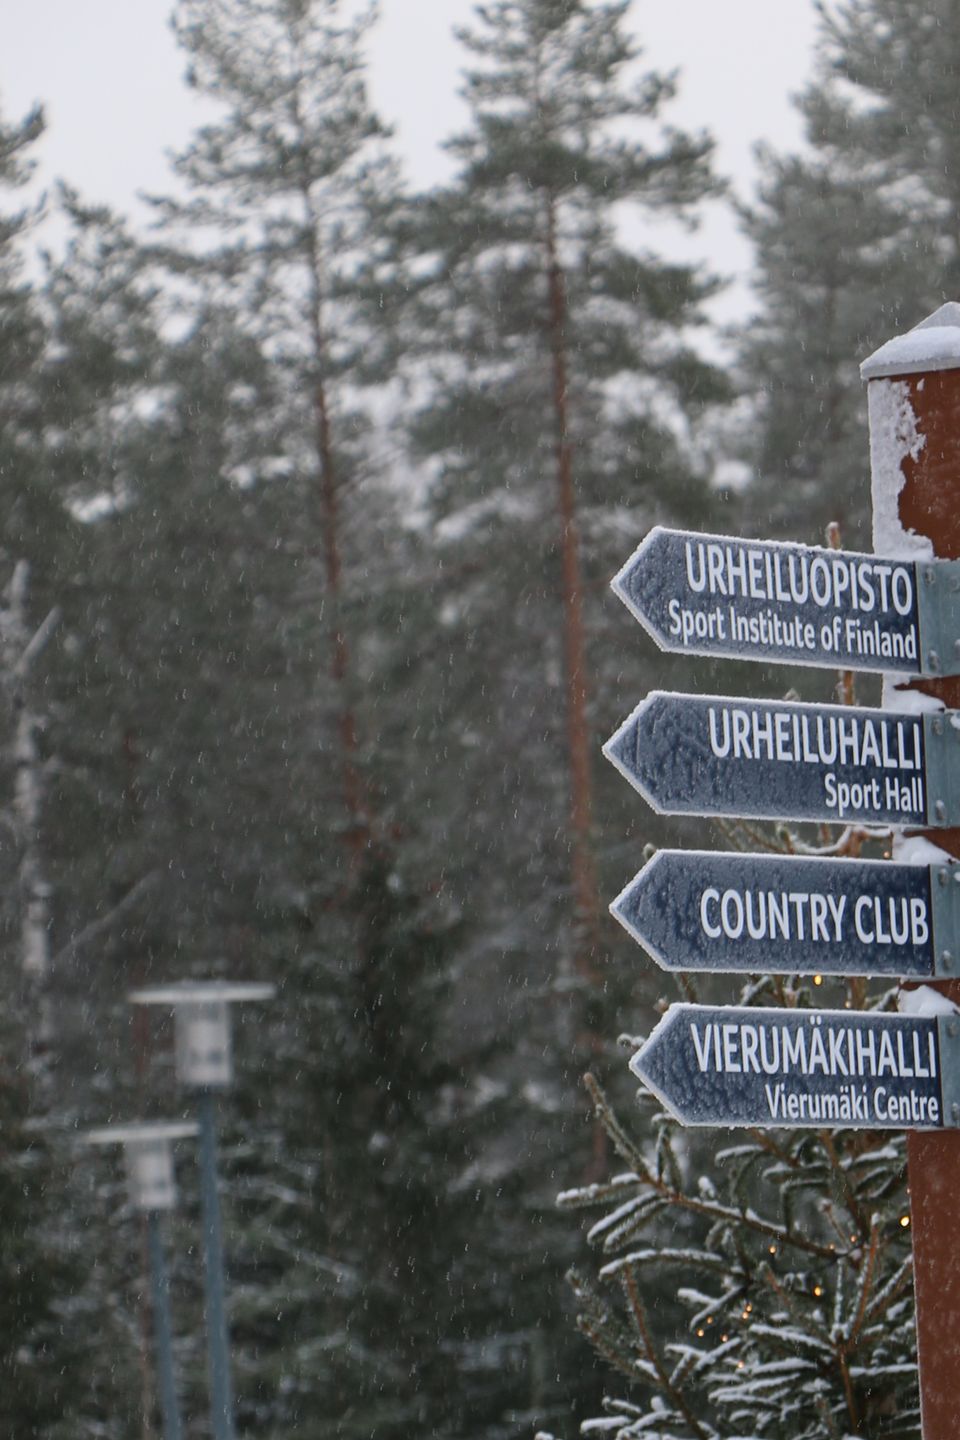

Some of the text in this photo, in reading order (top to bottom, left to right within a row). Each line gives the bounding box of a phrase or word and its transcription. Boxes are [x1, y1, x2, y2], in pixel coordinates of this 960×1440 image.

[686, 543, 913, 615] URHEILUOPISTO
[668, 599, 917, 659] Sport Institute of Finland
[708, 708, 922, 770] URHEILUHALLI
[824, 773, 924, 816] Sport Hall
[700, 888, 929, 945] COUNTRY CLUB
[690, 1016, 937, 1078] VIERUMÄKIHALLI
[765, 1084, 939, 1121] Vierumäki Centre
